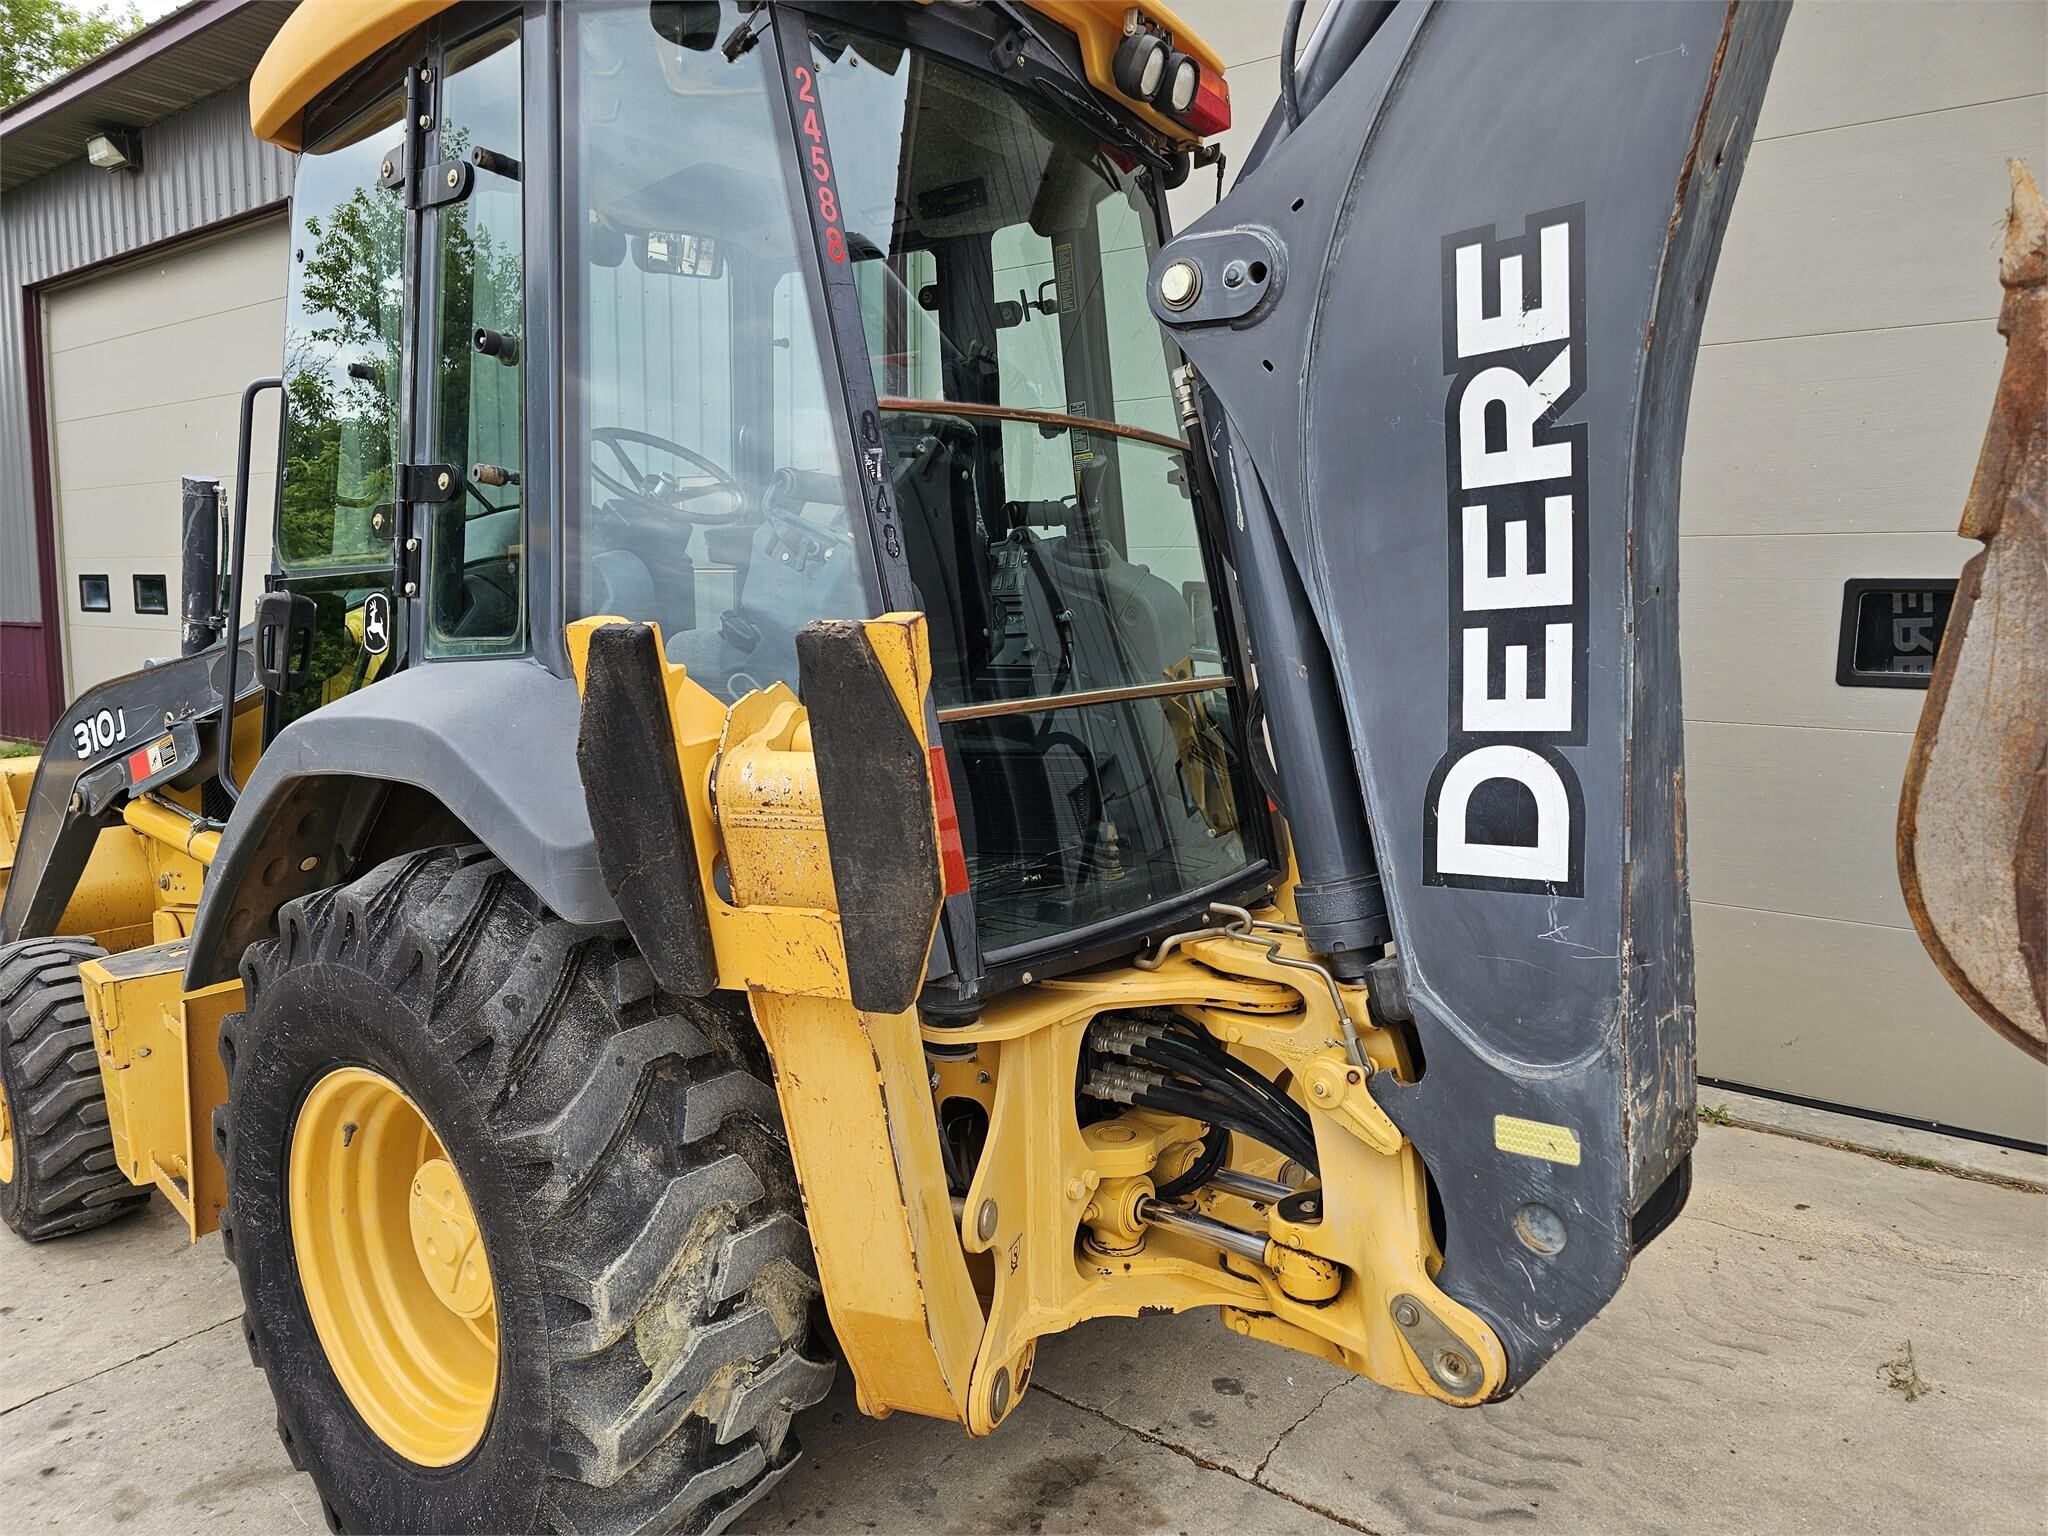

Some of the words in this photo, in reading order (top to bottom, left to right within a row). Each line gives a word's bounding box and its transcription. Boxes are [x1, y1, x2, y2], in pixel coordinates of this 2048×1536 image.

[795, 66, 845, 264] 24588
[1436, 222, 1573, 882] DEERE
[74, 707, 127, 760] 310J
